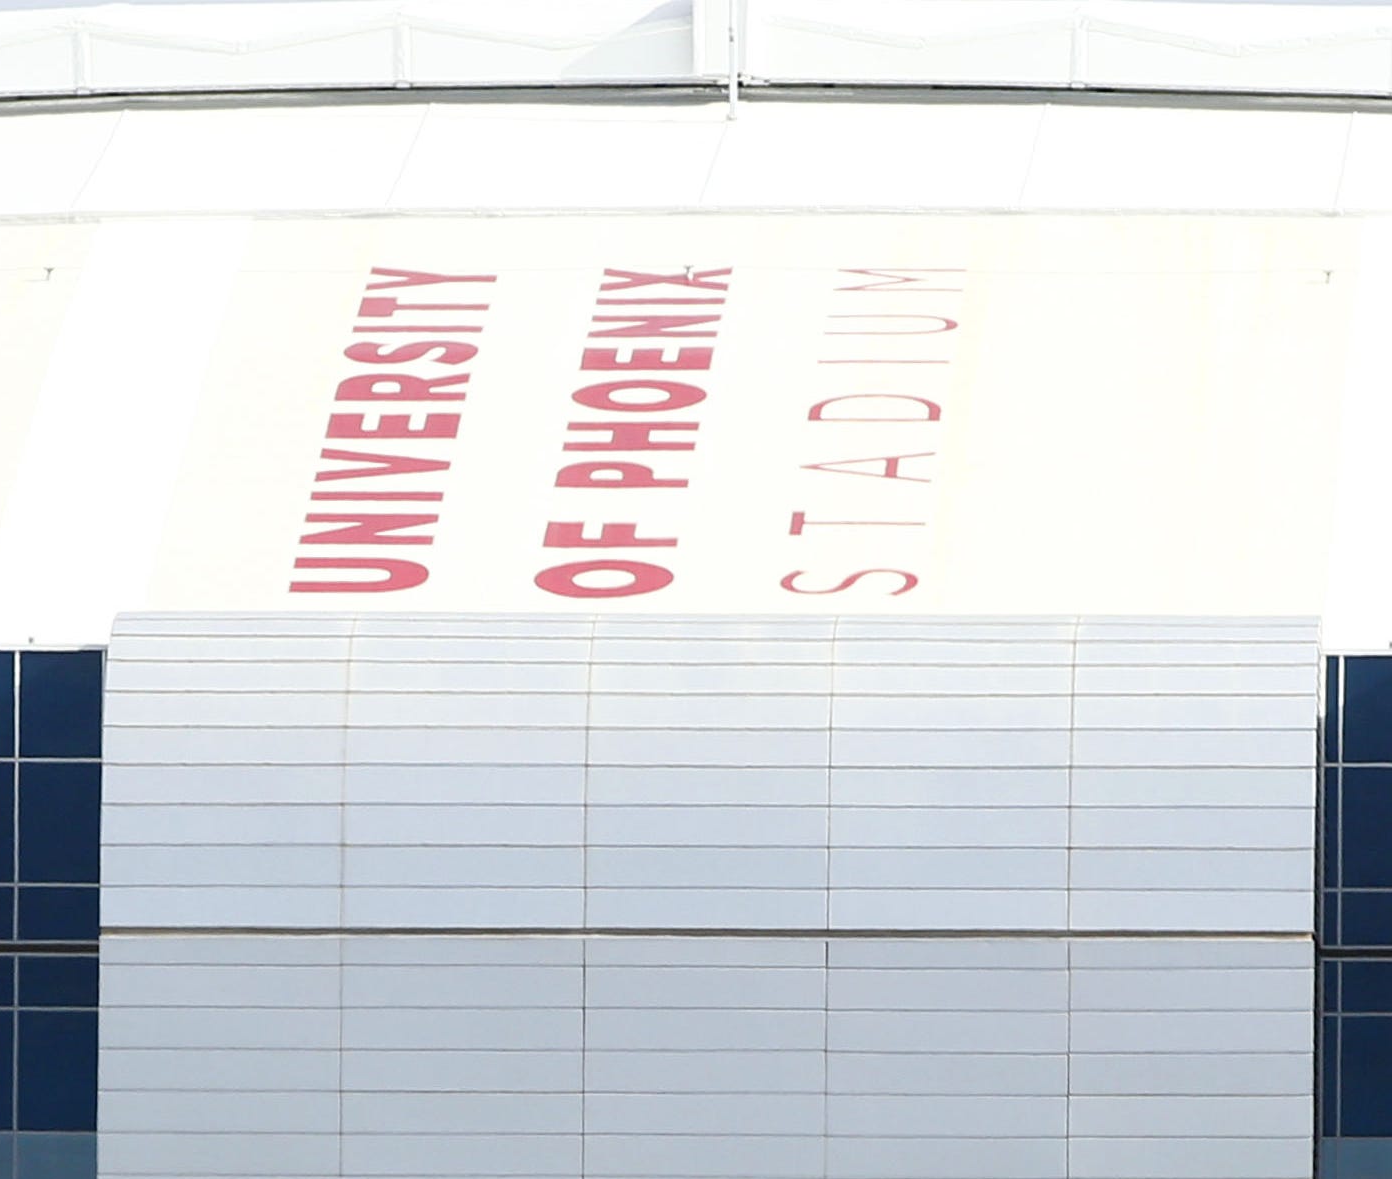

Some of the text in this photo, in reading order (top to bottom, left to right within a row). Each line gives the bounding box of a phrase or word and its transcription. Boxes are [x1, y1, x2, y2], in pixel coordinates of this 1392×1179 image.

[289, 266, 497, 593] UNIVERSITY
[534, 266, 733, 599] OF PHOENIX
[779, 268, 967, 596] STADIUM
